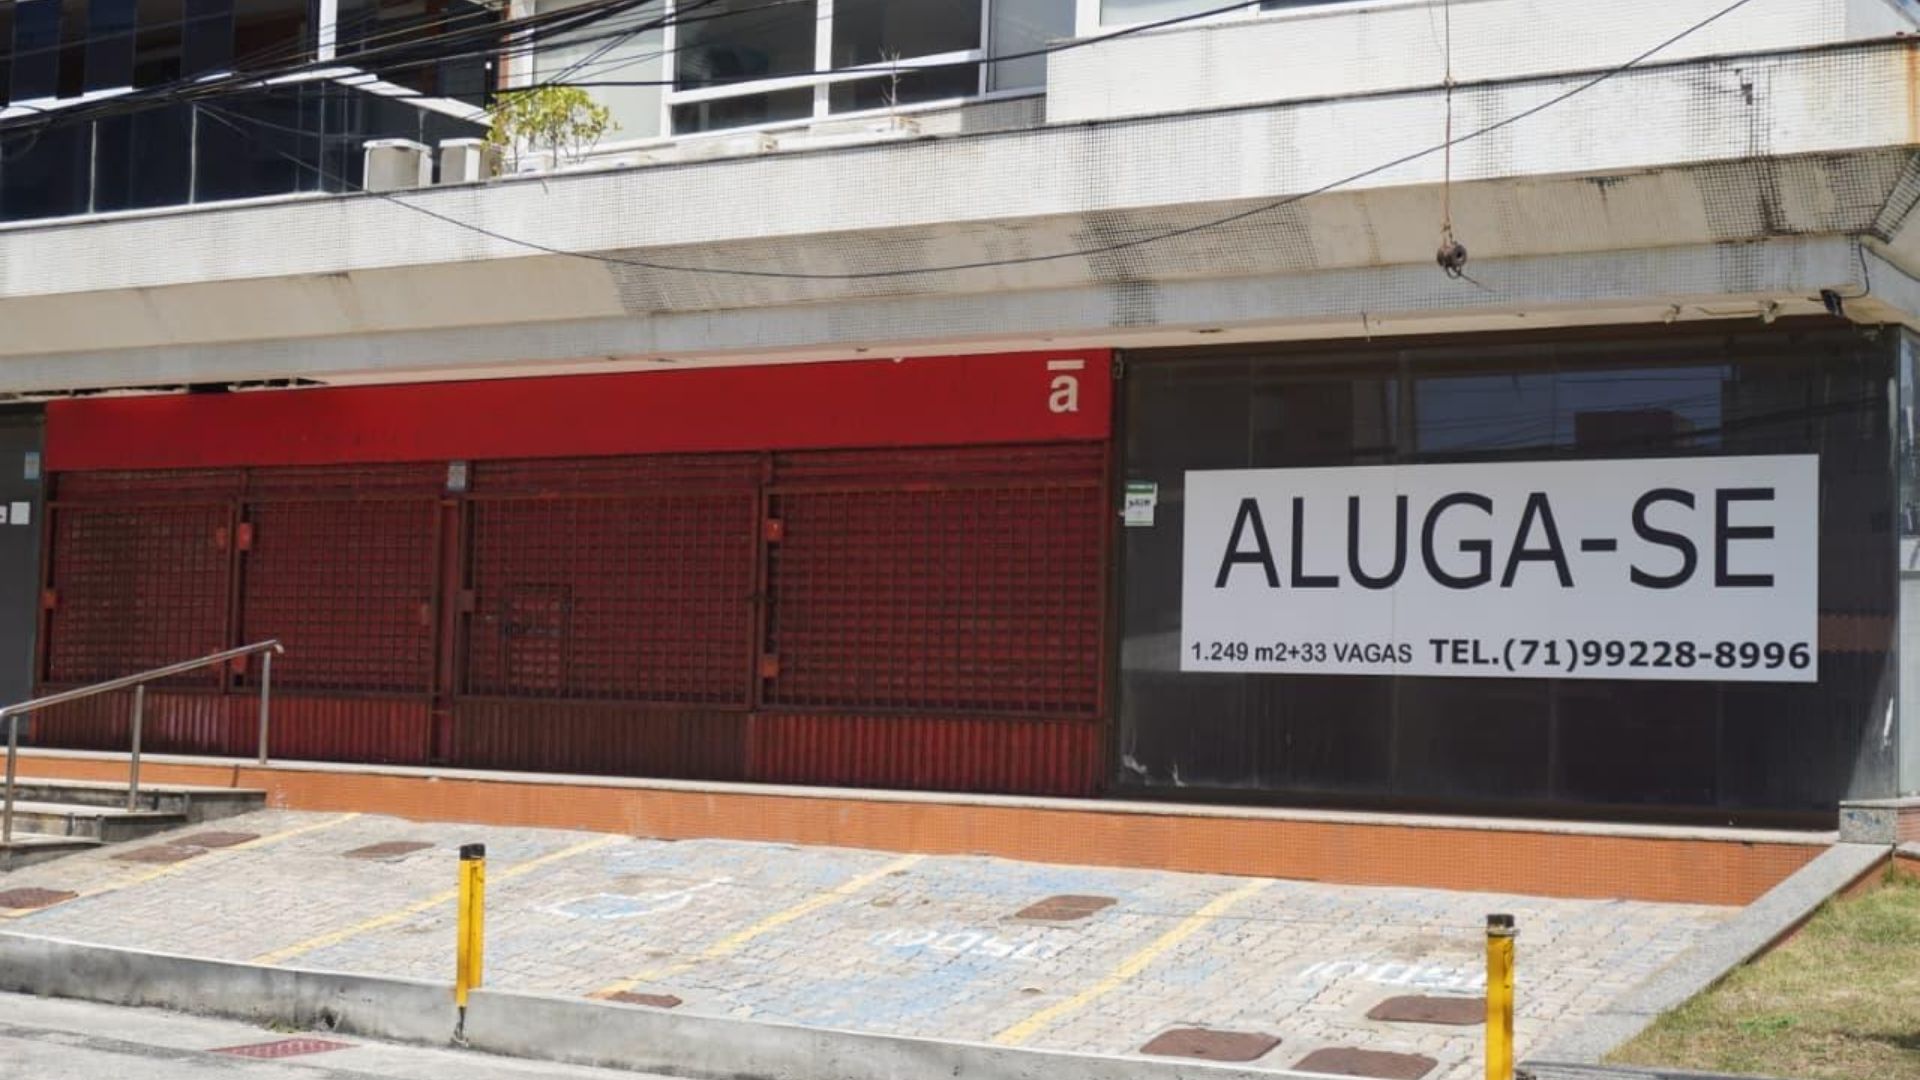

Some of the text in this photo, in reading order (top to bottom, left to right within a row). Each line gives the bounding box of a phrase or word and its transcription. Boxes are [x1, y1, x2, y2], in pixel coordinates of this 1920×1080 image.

[1214, 487, 1776, 590] ALUGA-SE
[1191, 641, 1249, 662] 1.249
[1254, 641, 1328, 663] m2+33
[1333, 642, 1413, 664] VAGAS
